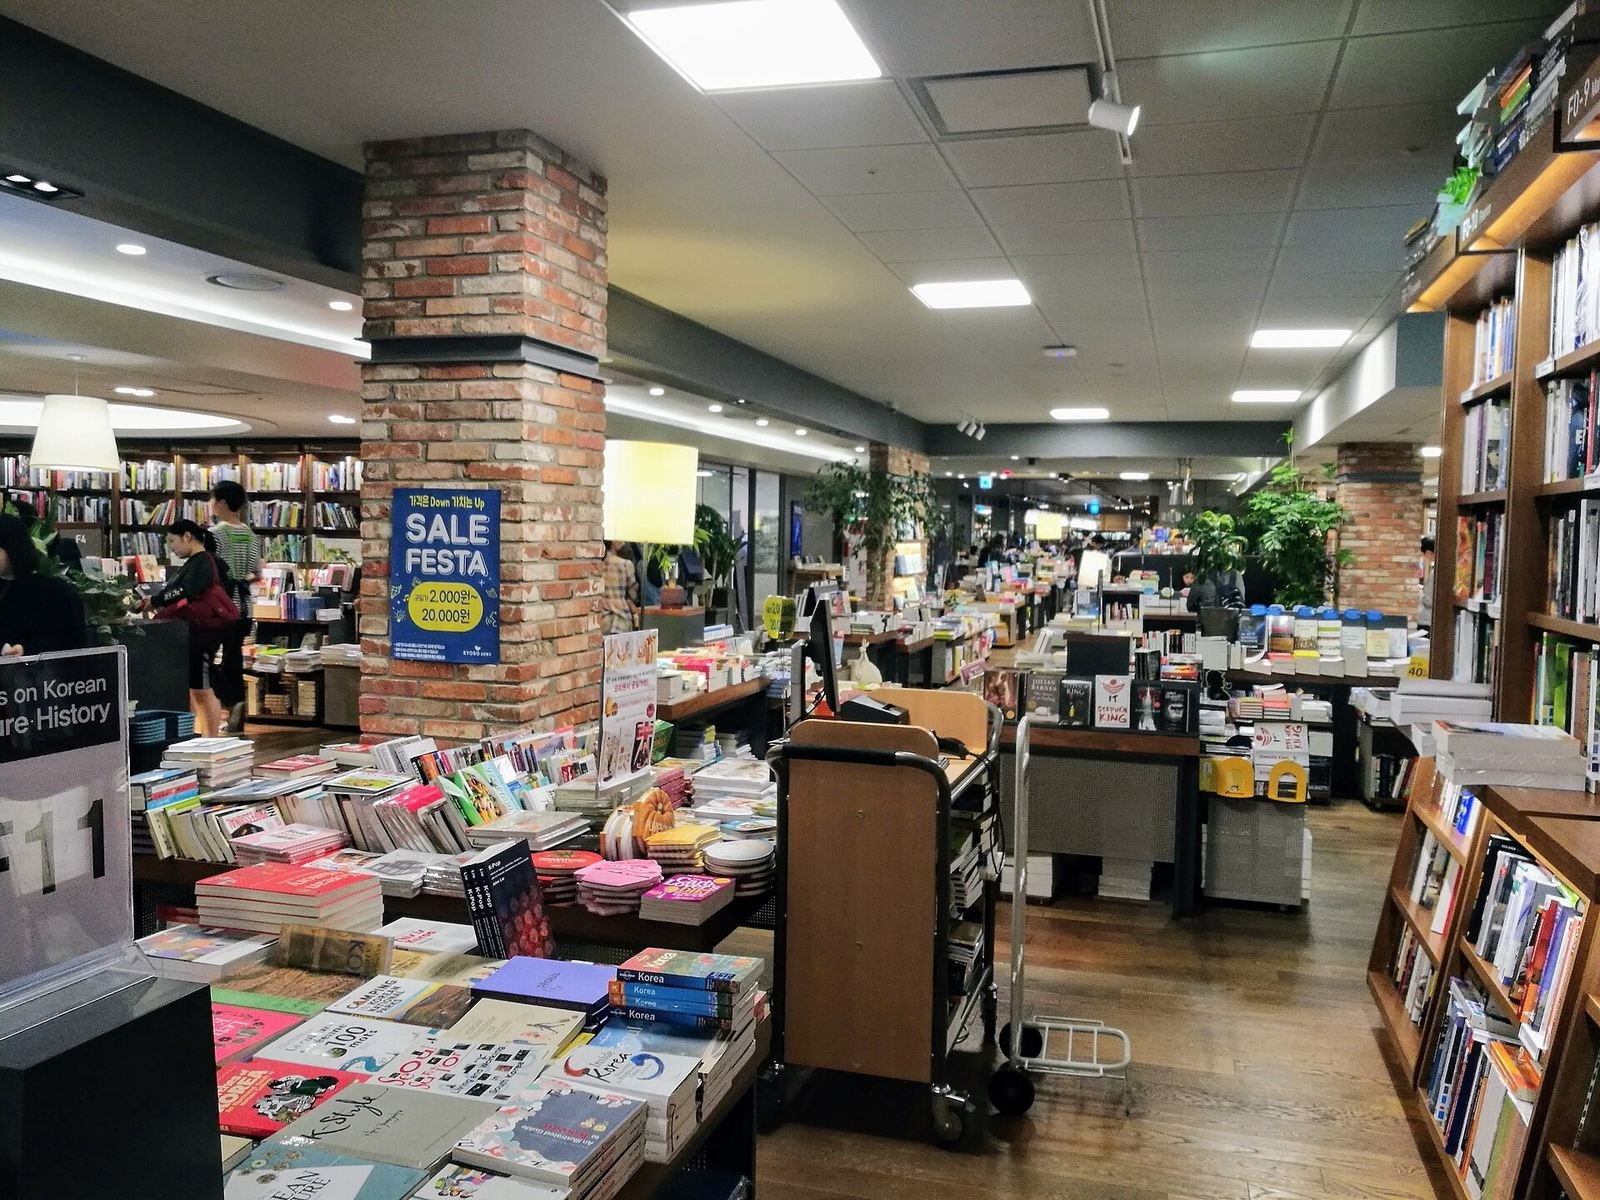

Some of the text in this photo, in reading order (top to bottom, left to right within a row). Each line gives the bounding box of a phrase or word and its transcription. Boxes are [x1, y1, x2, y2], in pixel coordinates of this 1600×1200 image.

[409, 495, 485, 511] 가격은 Down 가치는 Up
[406, 513, 490, 545] SALE
[406, 548, 489, 577] FESTA
[14, 687, 37, 704] on
[44, 677, 107, 698] Korean
[1108, 695, 1118, 703] IT
[1099, 714, 1127, 723] KING
[1292, 725, 1302, 750] KING
[643, 952, 678, 968] Korea
[638, 972, 664, 983] Korea
[347, 980, 397, 1009] CAMPING
[633, 986, 656, 996] Korea
[635, 998, 657, 1008] Korea
[629, 1009, 655, 1021] Korea
[325, 1026, 366, 1046] 100
[349, 1029, 378, 1048] mots
[587, 1053, 632, 1083] Korea
[521, 1125, 544, 1136] Guide
[543, 1132, 583, 1145] Illustrated
[271, 1170, 320, 1200] EAN
